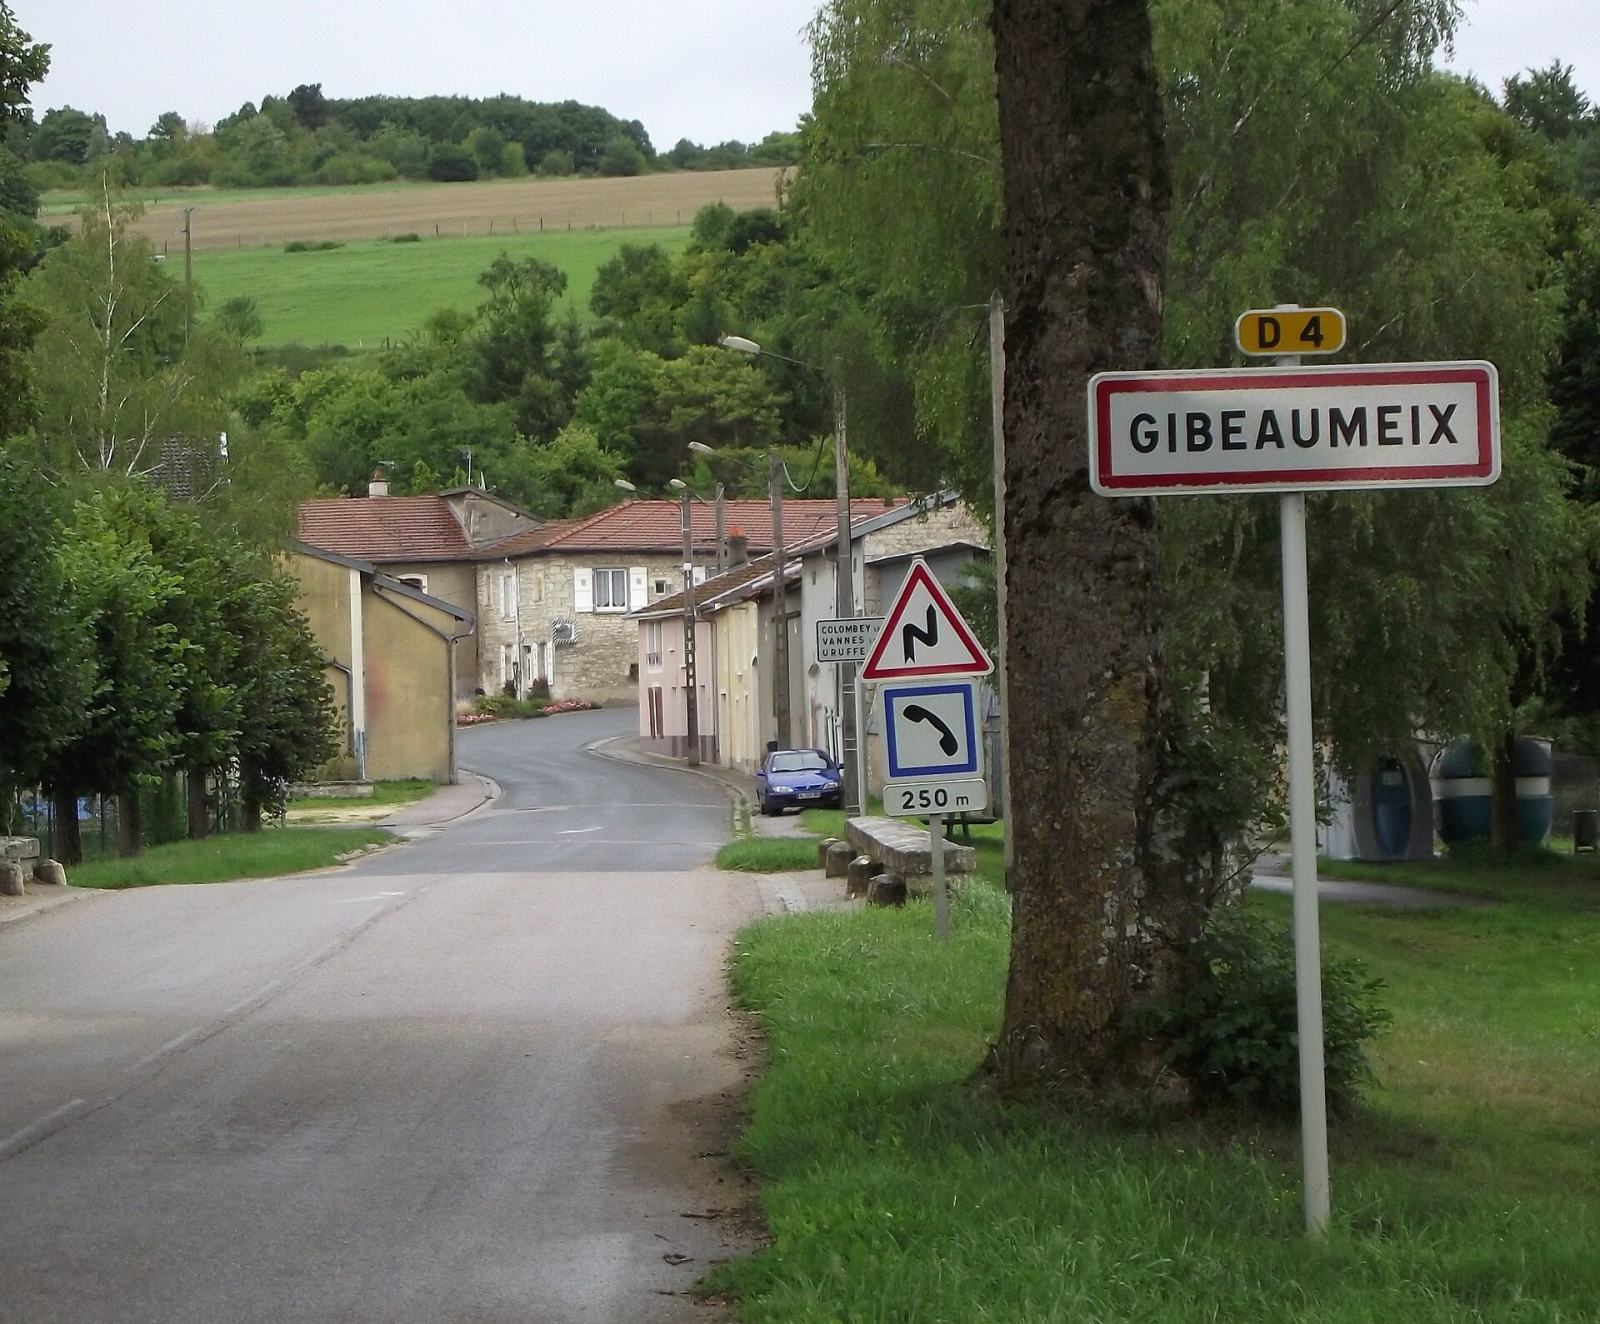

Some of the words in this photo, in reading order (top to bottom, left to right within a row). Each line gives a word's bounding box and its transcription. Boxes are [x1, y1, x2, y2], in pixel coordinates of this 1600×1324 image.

[1258, 317, 1281, 349] D
[1299, 315, 1324, 348] 4
[1130, 403, 1459, 454] GIBEAUMEIX
[821, 624, 871, 634] COLOMBEY
[822, 636, 865, 645] VANNES
[822, 647, 865, 657] URUFFE
[901, 788, 948, 809] 250
[956, 795, 969, 806] m
